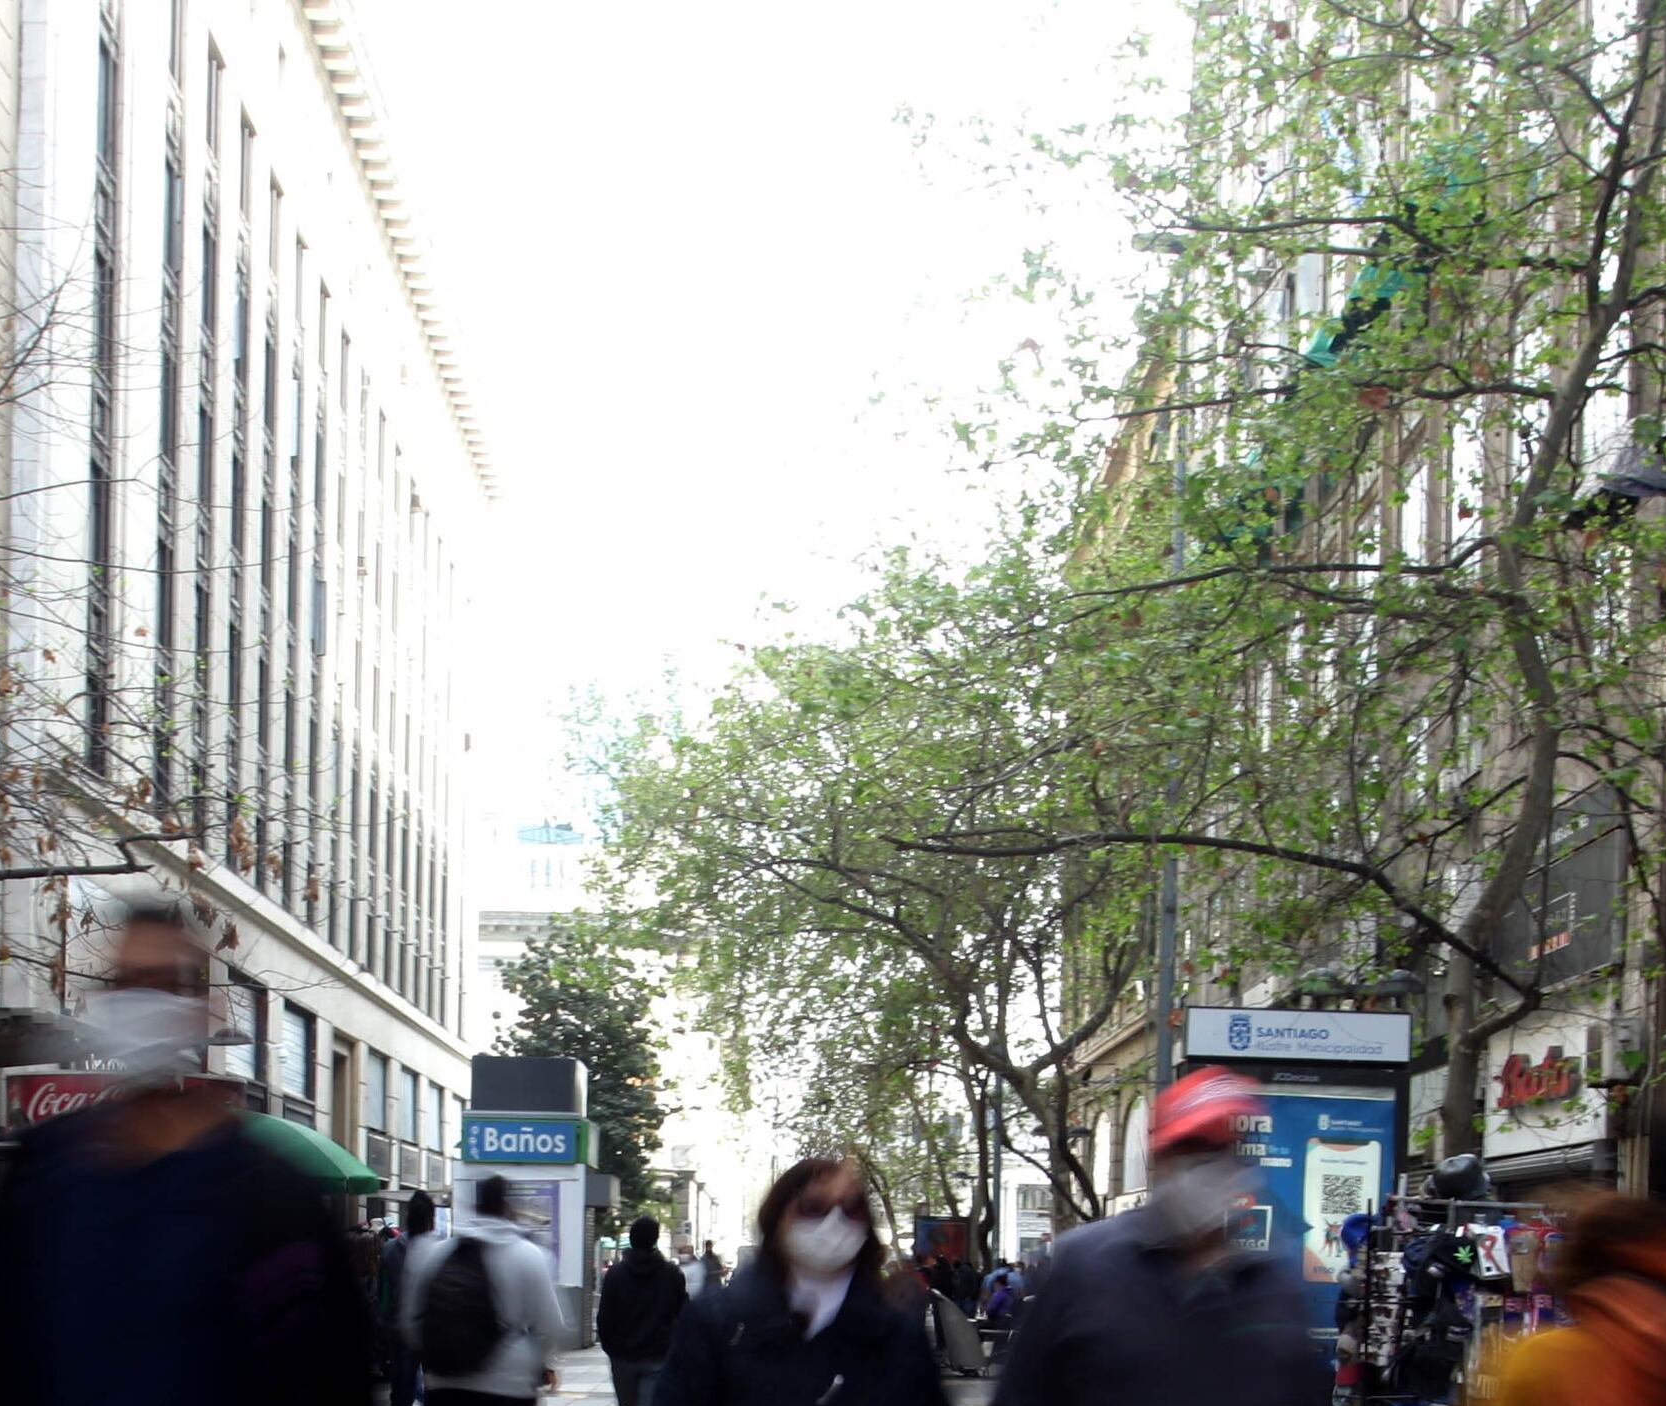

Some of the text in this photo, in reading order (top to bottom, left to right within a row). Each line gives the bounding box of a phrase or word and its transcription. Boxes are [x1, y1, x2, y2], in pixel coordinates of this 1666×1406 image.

[1256, 1026, 1329, 1040] SANTIAGO
[27, 1082, 127, 1125] Coca-C
[484, 1126, 566, 1153] Baños
